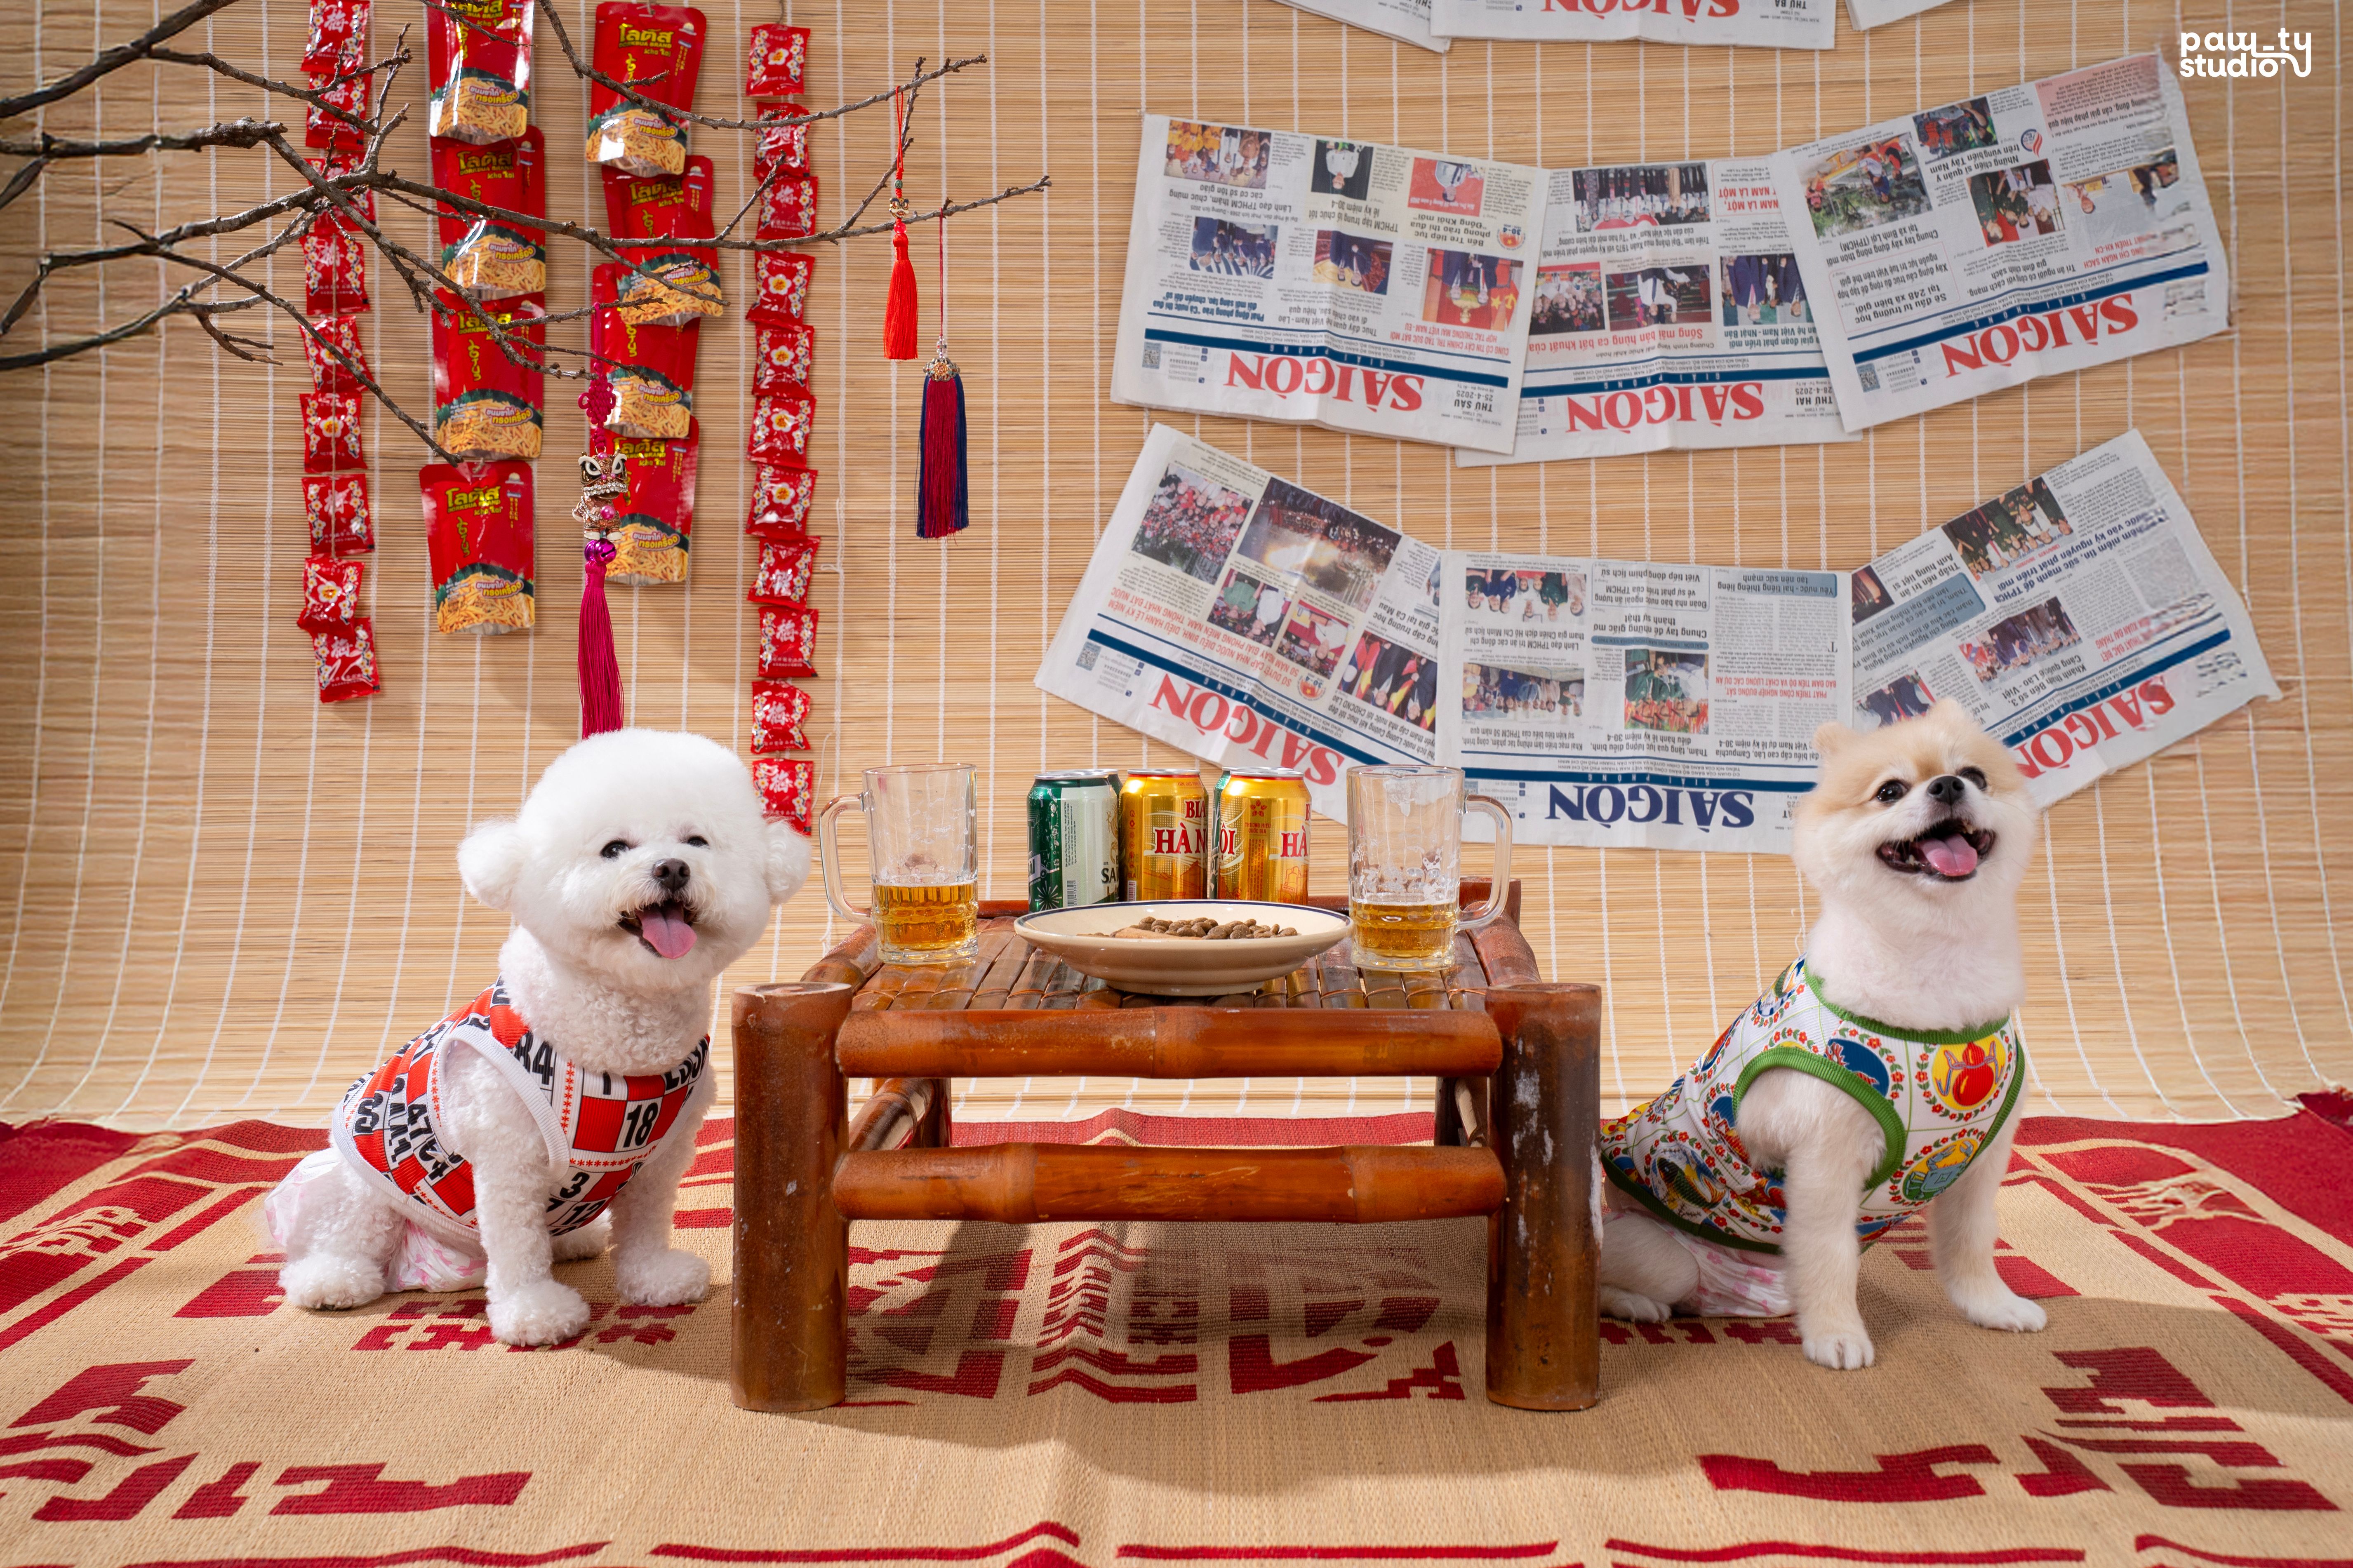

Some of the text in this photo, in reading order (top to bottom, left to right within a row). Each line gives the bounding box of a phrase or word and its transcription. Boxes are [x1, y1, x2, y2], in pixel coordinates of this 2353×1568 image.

[1941, 294, 2138, 376] SÀIGÒN
[1225, 352, 1424, 412] SÀIGÒN
[1456, 390, 1493, 402] 25-4-2025
[1795, 386, 1832, 395] 28-4-2025
[1454, 399, 1492, 412] THỨ SÁU
[1567, 382, 1764, 433] SÀIGÒN
[1796, 396, 1832, 405] THỨ HAI
[1373, 612, 1426, 640] cấp trường học
[1379, 602, 1430, 630] gia tại Cà Mau
[1185, 801, 1206, 818] BIA
[1549, 784, 1755, 833] SÀIGÒN
[1155, 823, 1193, 854] HÀ
[623, 1102, 659, 1148] 18
